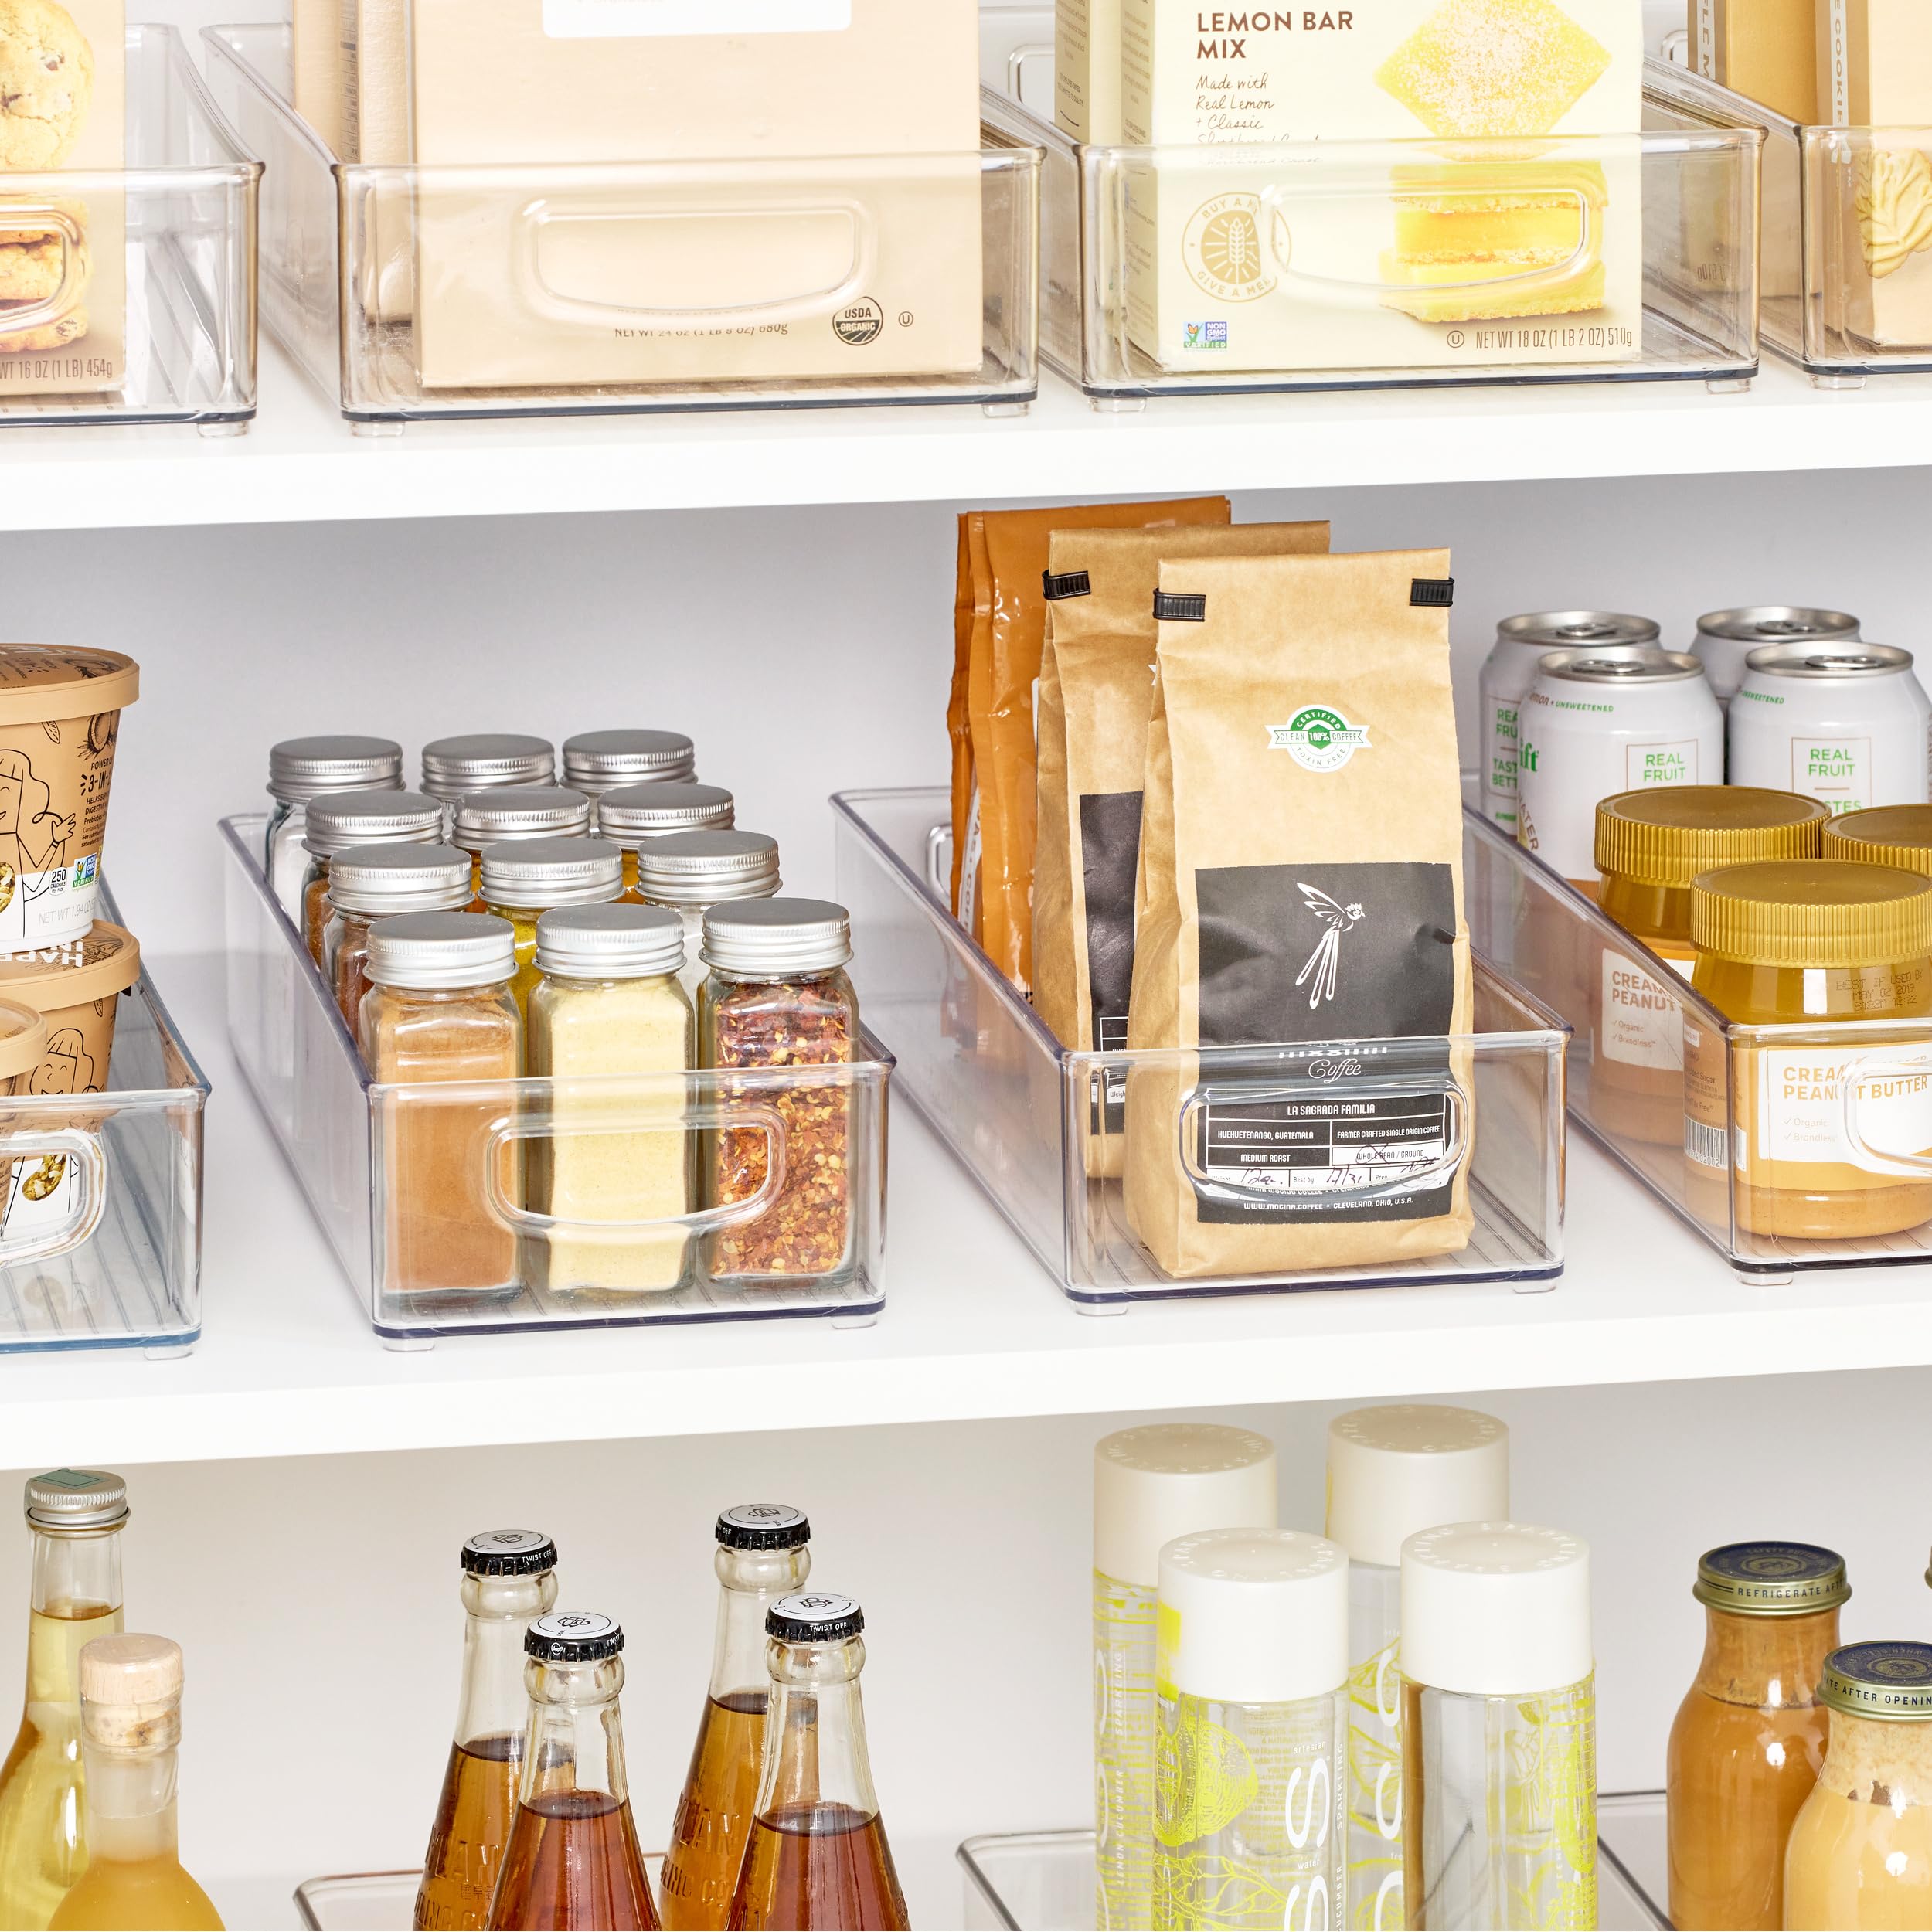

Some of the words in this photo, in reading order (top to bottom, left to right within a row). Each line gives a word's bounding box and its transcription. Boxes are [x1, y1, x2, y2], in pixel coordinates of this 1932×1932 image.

[1197, 12, 1291, 32] LEMON
[1303, 11, 1353, 30] BAR
[1196, 39, 1247, 59] MIX
[1835, 18, 1843, 124] COOKIE
[1196, 74, 1233, 90] Made
[1237, 72, 1269, 90] with
[1196, 94, 1226, 110] Real
[1230, 94, 1275, 110] Lemon
[1208, 114, 1264, 130] Classic
[1202, 199, 1227, 219] BUY
[1197, 270, 1226, 294] GIVE
[845, 308, 872, 318] USDA
[840, 321, 876, 332] ORGANIC
[1476, 331, 1495, 349] NET
[1498, 331, 1513, 348] WT
[1517, 330, 1529, 347] 18
[1533, 330, 1546, 347] OZ
[1549, 328, 1558, 349] (1
[1563, 328, 1575, 346] LB
[1579, 328, 1585, 346] 2
[1588, 328, 1604, 348] OZ)
[1608, 327, 1632, 346] 510g
[19, 361, 31, 379] 16
[35, 360, 48, 378] OZ
[52, 359, 60, 380] (1
[66, 359, 83, 379] LB)
[87, 359, 112, 378] 454g
[1555, 700, 1614, 712] UNSWEETENED
[1296, 711, 1341, 729] CERTIFIED
[1497, 708, 1518, 723] REA
[1280, 733, 1305, 741] CLEAN
[1309, 732, 1330, 741] 100%
[1332, 733, 1357, 741] COFFEE
[1296, 747, 1321, 765] TOXIN
[1327, 748, 1346, 765] FREE
[1645, 753, 1684, 767] REAL
[1810, 748, 1853, 761] REAL
[90, 757, 109, 771] POWER
[1808, 764, 1855, 777] FRUIT
[1644, 767, 1685, 782] FRUIT
[51, 869, 66, 883] 250
[73, 876, 94, 887] VERIFIED
[39, 911, 56, 926] NET
[57, 907, 70, 920] WT
[1836, 978, 1866, 991] BEST
[1874, 976, 1886, 988] IF
[1890, 972, 1911, 985] USED
[1618, 1020, 1645, 1033] Organic
[1308, 1058, 1362, 1084] Coffee
[1871, 1075, 1928, 1099] BUTTER
[1287, 1106, 1298, 1116] LA
[1300, 1104, 1338, 1116] SAGRADA
[1342, 1104, 1376, 1114] FAMILIA
[1218, 1131, 1274, 1141] HUEHUETENANGO,
[1275, 1131, 1314, 1140] GUATEMALA
[1362, 1129, 1386, 1138] CRAFTED
[1386, 1128, 1405, 1137] SINGLE
[1406, 1128, 1423, 1136] ORIGIN
[1423, 1125, 1440, 1134] COFFEE
[1270, 1154, 1291, 1162] ROAST
[1356, 1152, 1377, 1161] WHOLE
[1401, 1149, 1424, 1158] GROUND
[1333, 1201, 1373, 1209] CLEVELAND,
[522, 1553, 542, 1563] TWIST
[543, 1549, 552, 1558] OFF
[1738, 1587, 1821, 1598] REFRIGERATE
[810, 1624, 832, 1632] TWIST
[835, 1621, 847, 1631] OFF
[1114, 1651, 1123, 1736] SPARKLING
[1842, 1685, 1877, 1702] AFTER
[1884, 1695, 1932, 1706] OPENIN
[1293, 1742, 1326, 1754] artesian
[1298, 1859, 1321, 1870] water
